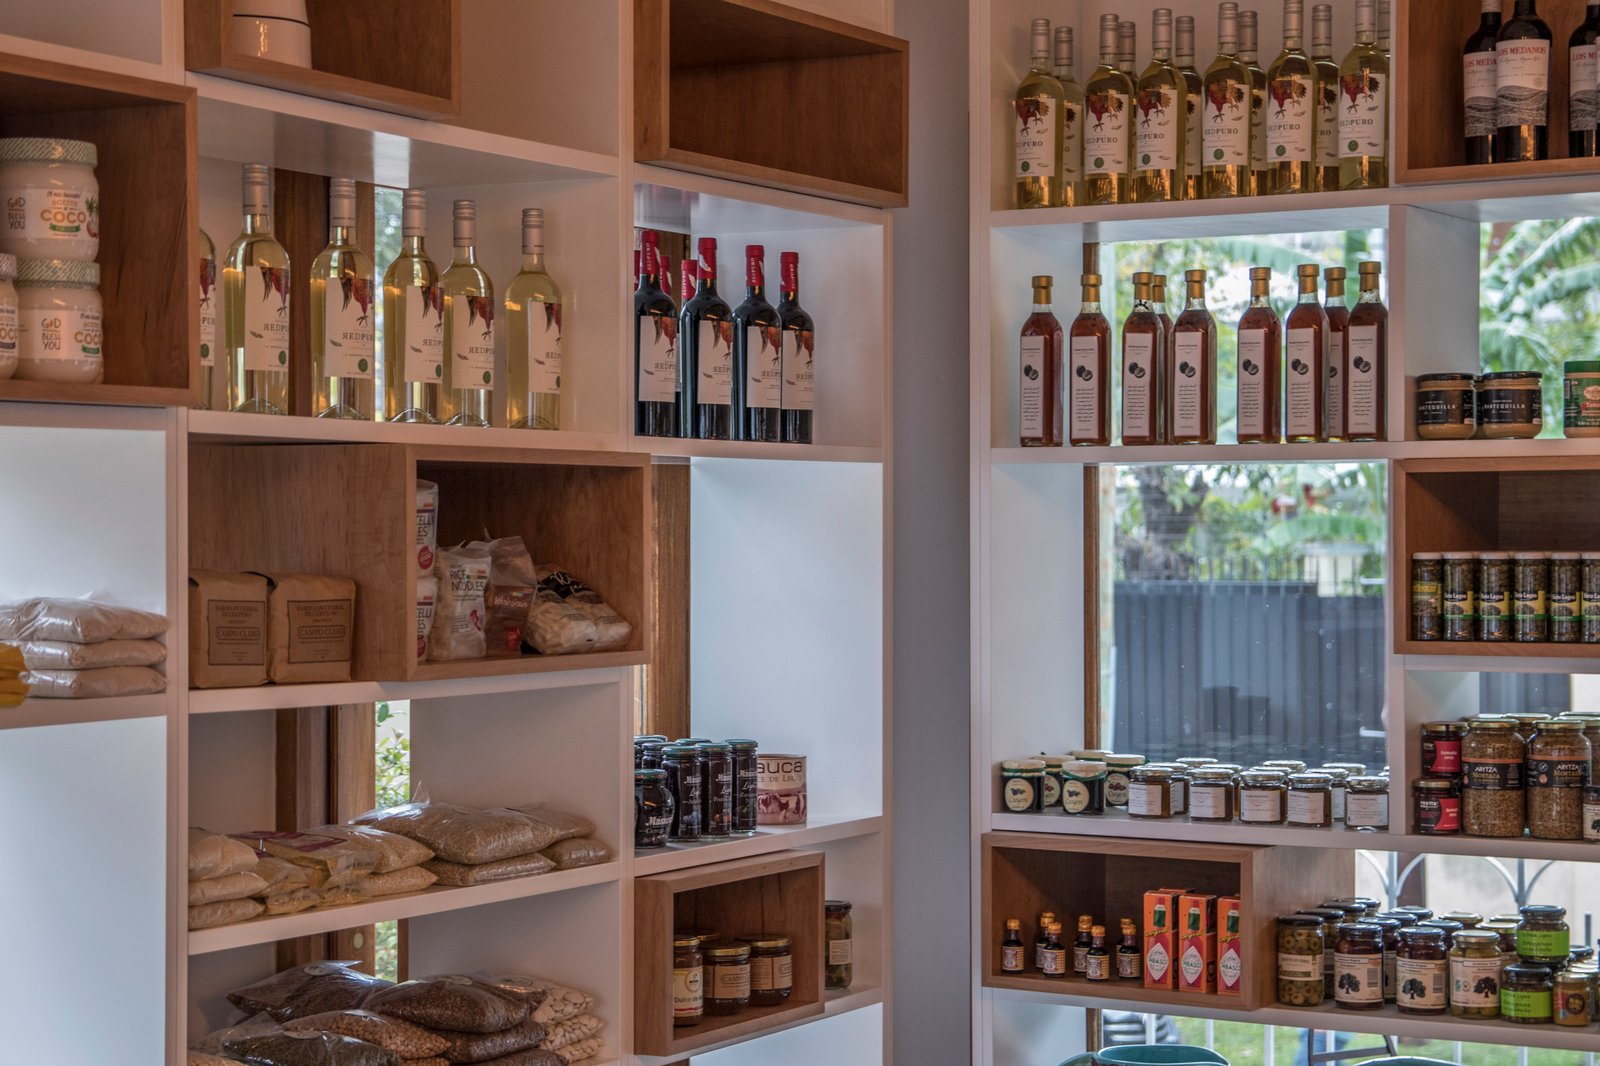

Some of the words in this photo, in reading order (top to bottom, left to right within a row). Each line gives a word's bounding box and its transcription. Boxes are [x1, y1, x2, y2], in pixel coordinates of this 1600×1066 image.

[1499, 48, 1509, 56] LOS
[1510, 46, 1547, 55] MEDANOS
[40, 209, 86, 224] COCO
[9, 220, 25, 230] YOU
[43, 341, 61, 350] YOU
[449, 569, 465, 580] RICE
[451, 581, 484, 591] NOODLES
